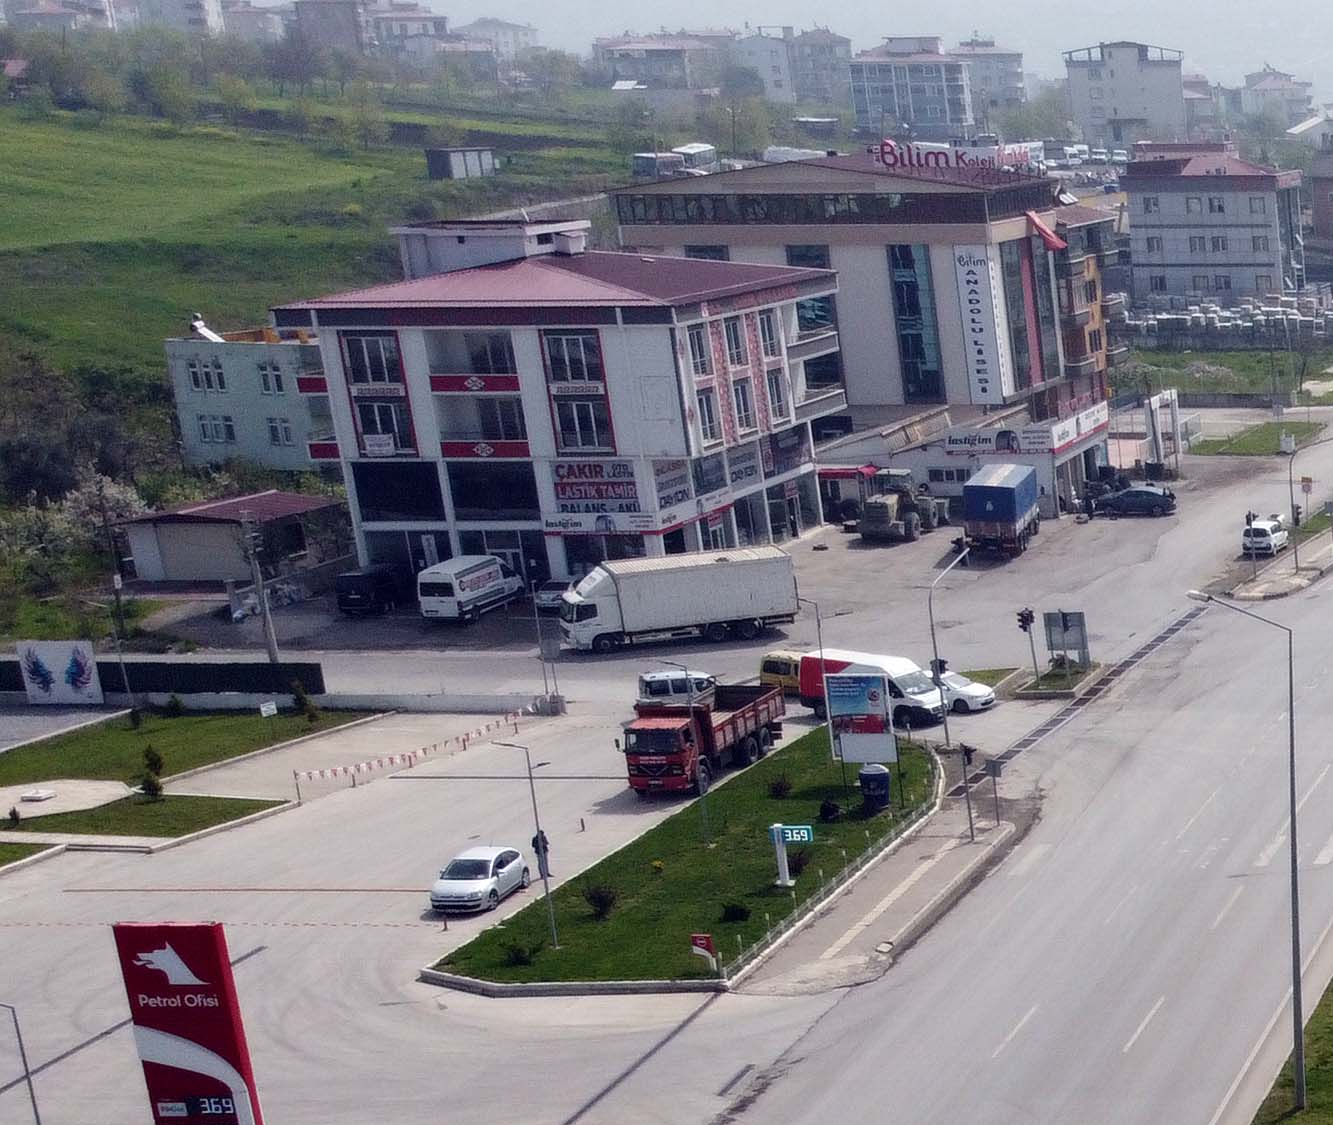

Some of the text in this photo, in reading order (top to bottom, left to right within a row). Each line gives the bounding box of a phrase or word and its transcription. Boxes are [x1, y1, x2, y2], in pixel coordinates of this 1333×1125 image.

[880, 141, 950, 168] Bilim
[955, 150, 995, 169] Koleji
[957, 256, 986, 268] Bilim
[966, 269, 984, 334] ANADOLU
[138, 994, 219, 1008] Petrol Ofisi
